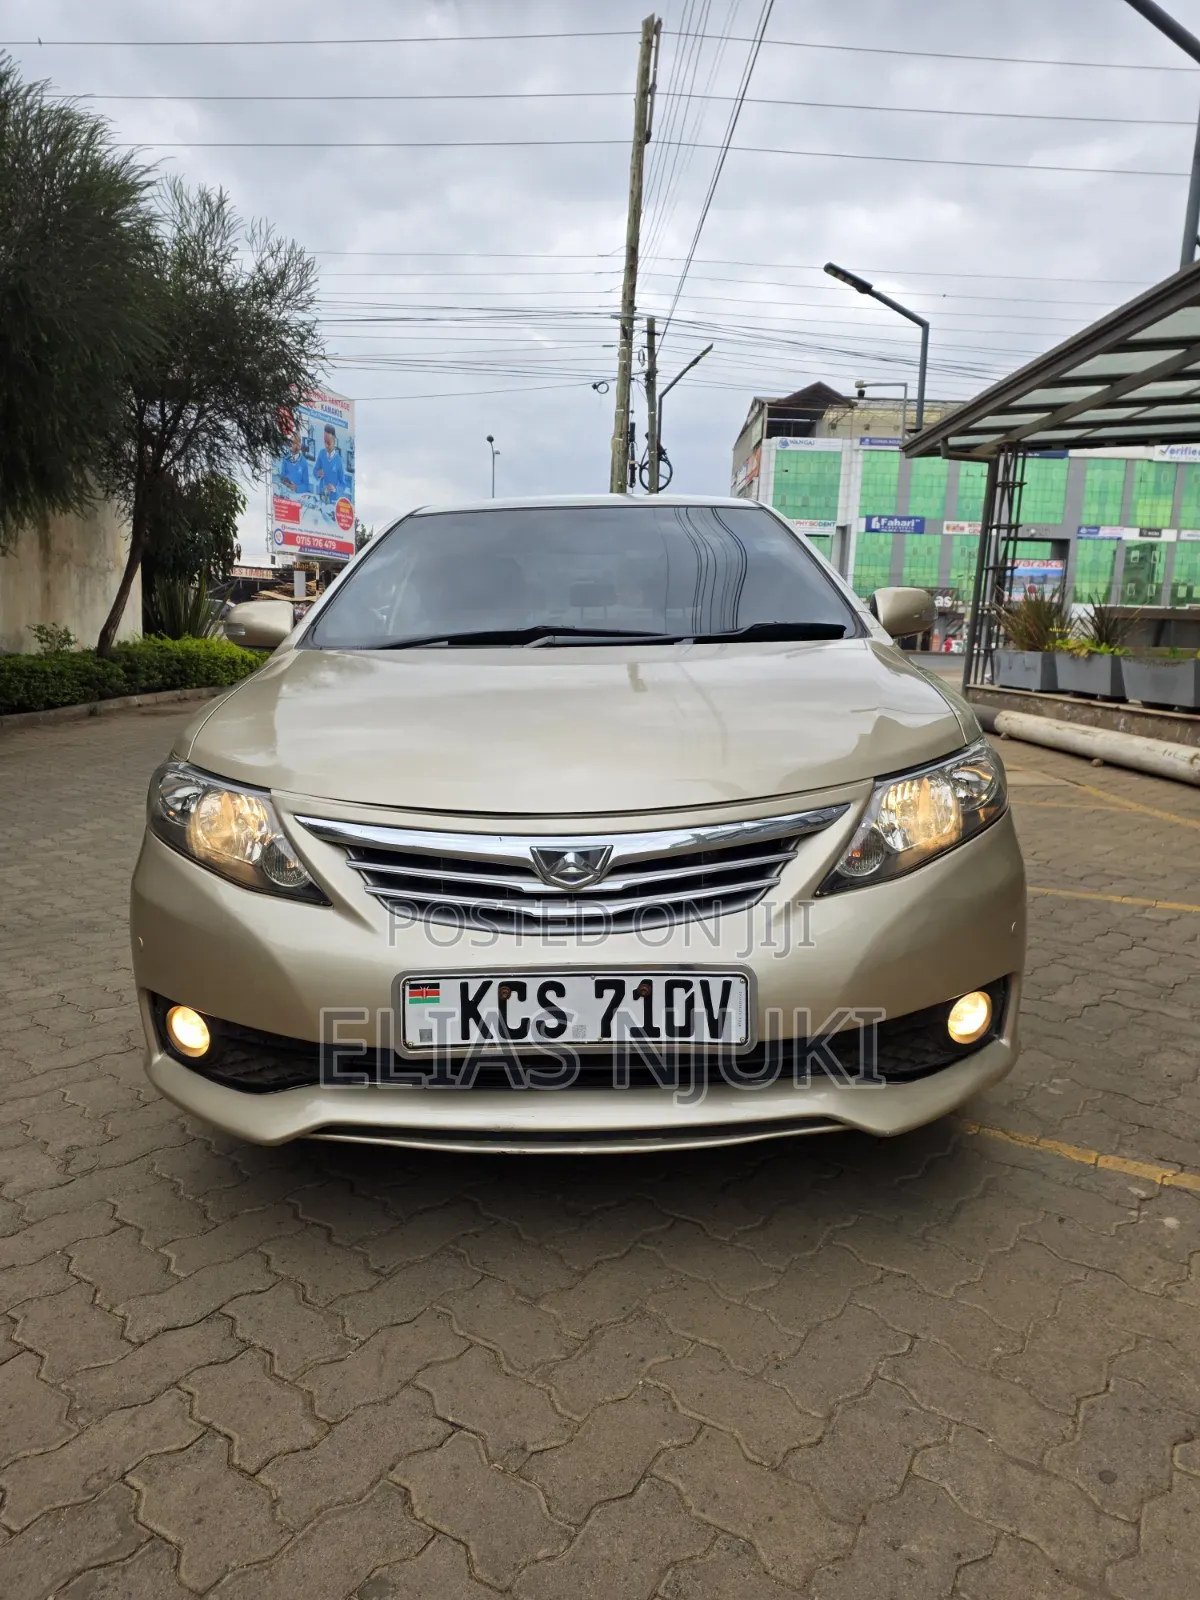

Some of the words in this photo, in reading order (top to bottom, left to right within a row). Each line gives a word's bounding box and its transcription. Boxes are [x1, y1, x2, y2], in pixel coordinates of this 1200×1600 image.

[795, 520, 836, 528] PHYSIODENT
[880, 518, 915, 528] Fahari
[295, 535, 311, 545] 0715
[312, 537, 323, 548] 176
[324, 539, 337, 550] 479
[460, 980, 568, 1041] KCS
[594, 978, 733, 1039] 710V
